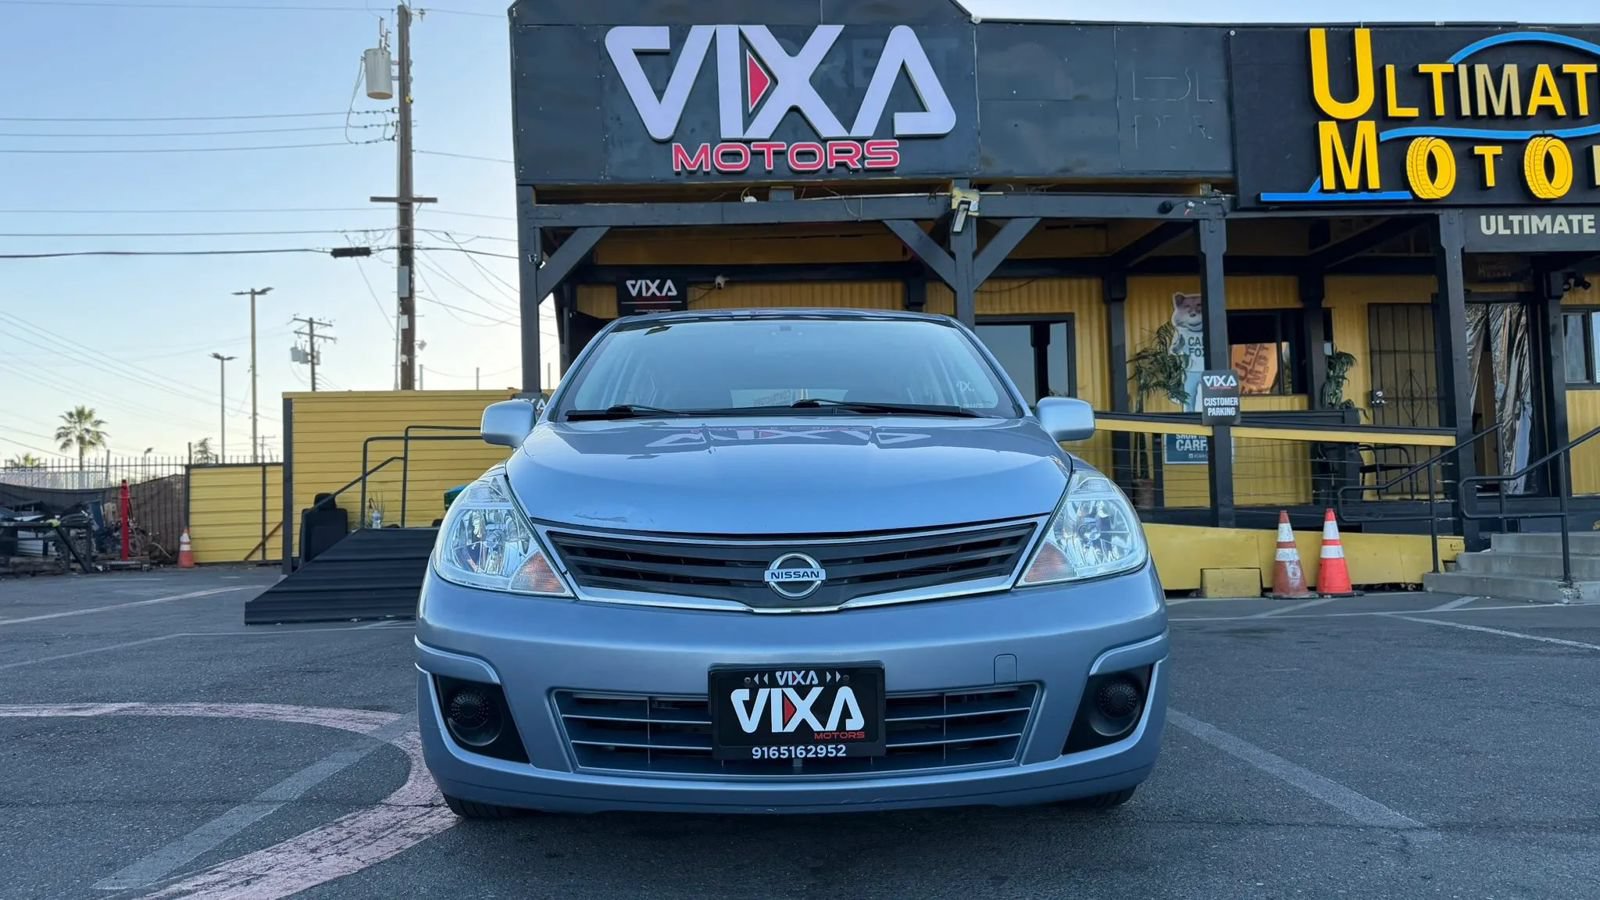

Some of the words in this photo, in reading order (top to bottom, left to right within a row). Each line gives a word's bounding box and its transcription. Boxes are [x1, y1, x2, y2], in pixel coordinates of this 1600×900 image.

[605, 25, 956, 142] VIXA
[672, 139, 900, 172] MOTORS
[1480, 214, 1596, 235] ULTIMATE
[625, 279, 678, 297] VIXA
[1203, 375, 1237, 387] VIXA
[1203, 397, 1239, 407] CUSTOMER
[1207, 407, 1236, 416] PARKING
[1175, 440, 1208, 451] CARF
[770, 570, 820, 580] NISSAN
[775, 671, 819, 686] VIXA
[731, 686, 865, 734] VIXA
[814, 732, 865, 740] MOTORS
[751, 745, 847, 759] 9165162952
